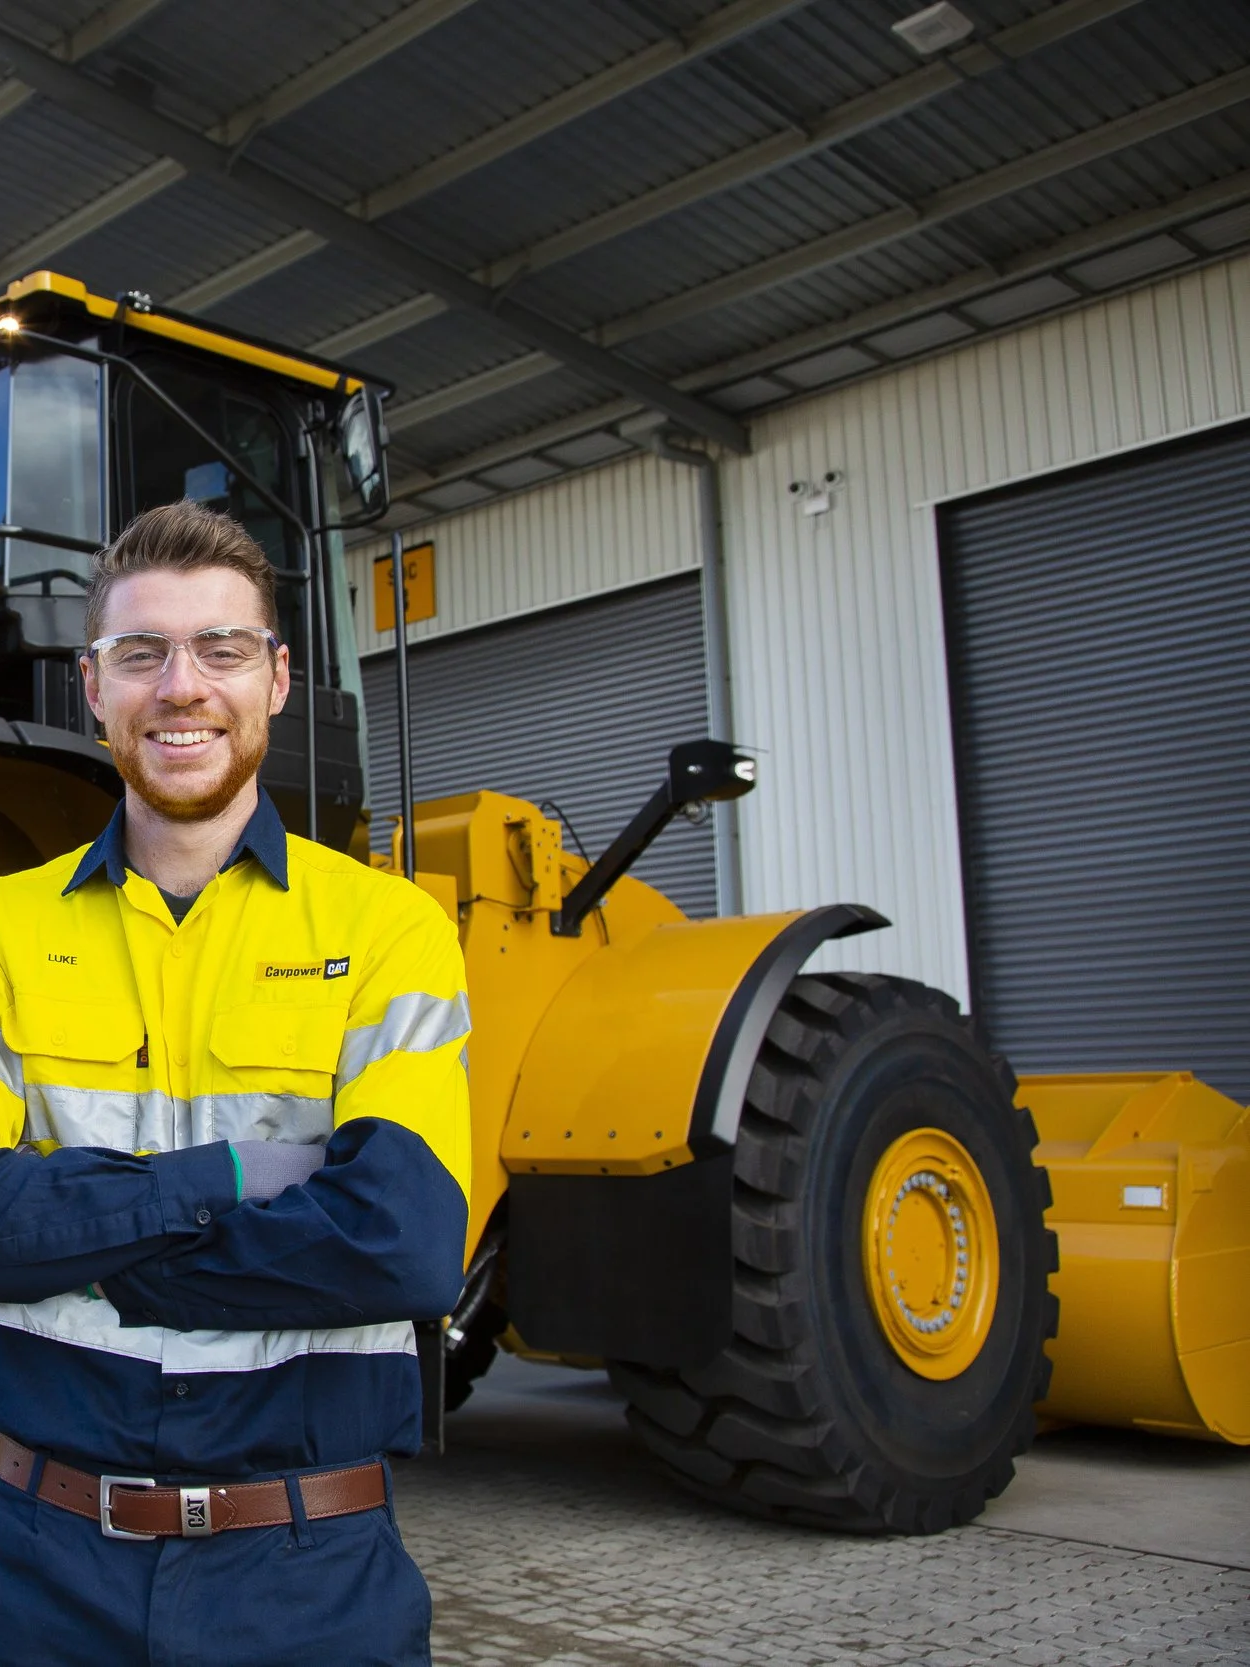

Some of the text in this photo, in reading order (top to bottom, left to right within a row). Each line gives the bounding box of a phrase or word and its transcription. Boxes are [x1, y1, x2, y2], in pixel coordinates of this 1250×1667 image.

[48, 953, 78, 965] LUKE
[265, 962, 349, 978] Cavpower CAT
[187, 1498, 205, 1528] CAT
